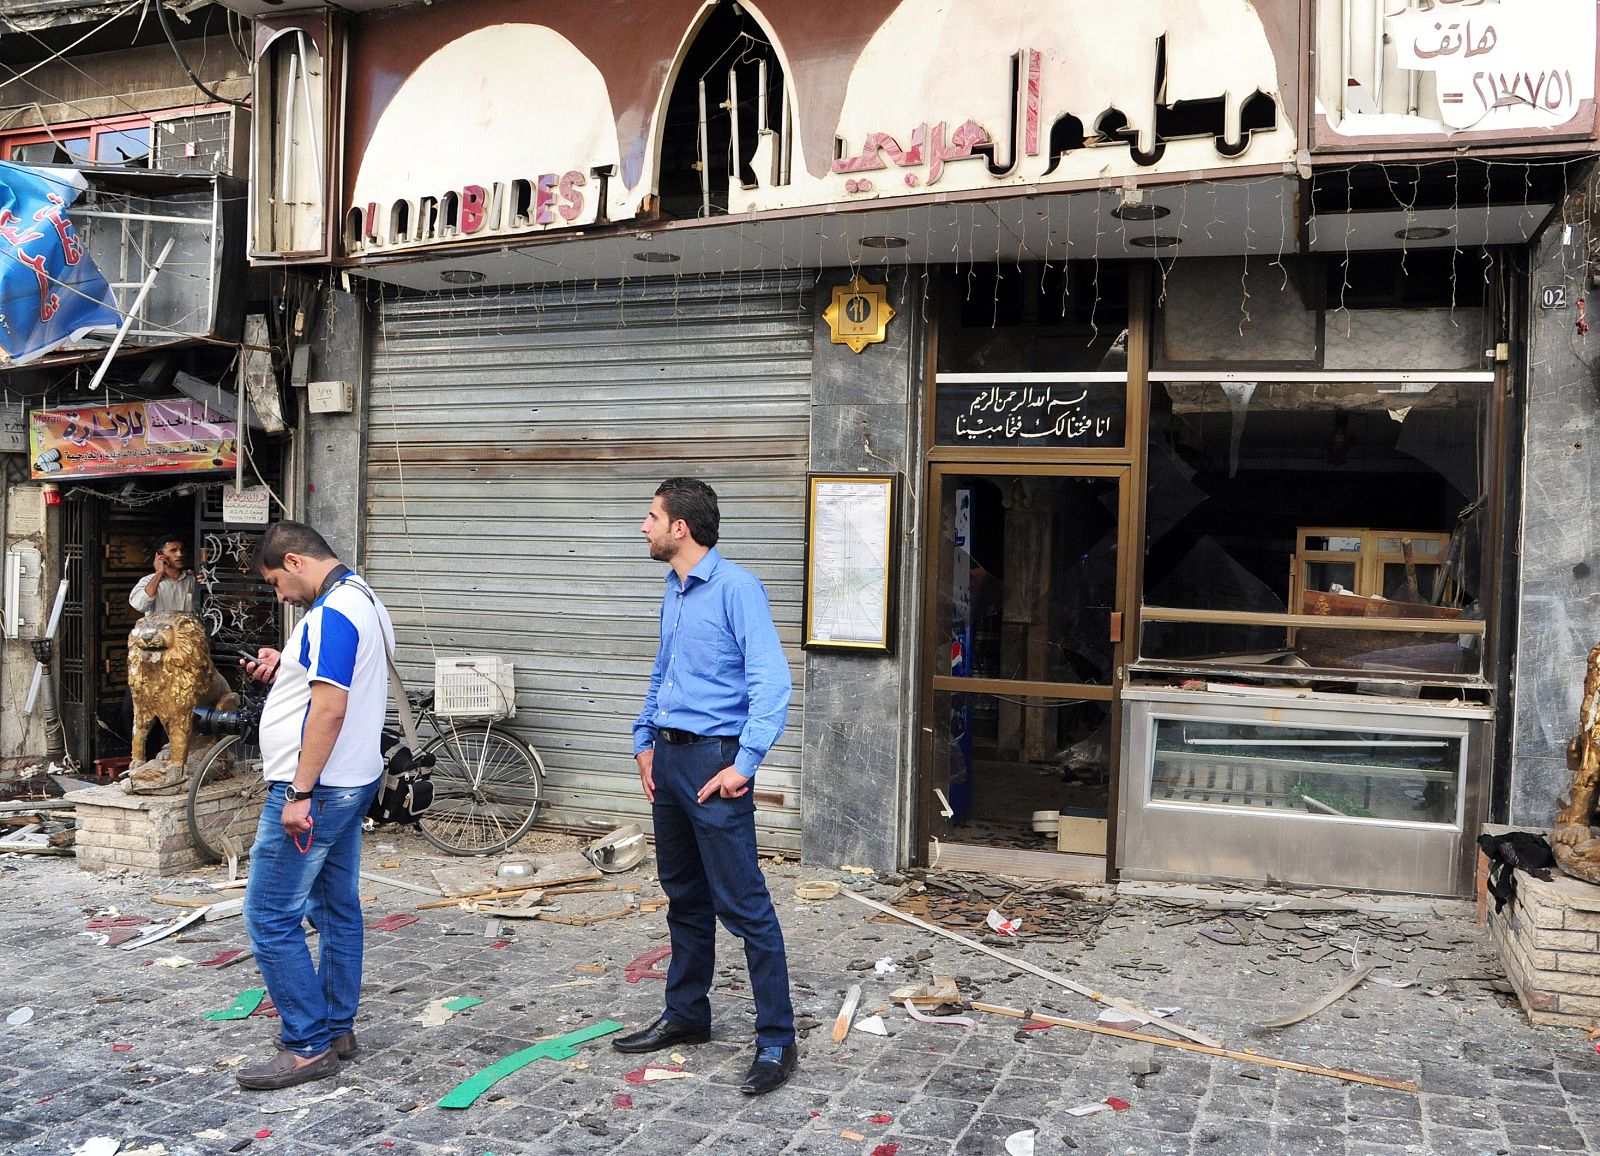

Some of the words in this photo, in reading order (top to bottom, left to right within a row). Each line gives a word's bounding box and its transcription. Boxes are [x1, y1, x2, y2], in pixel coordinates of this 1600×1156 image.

[1413, 19, 1497, 59] هاتف
[832, 47, 1041, 193] العربي
[1544, 289, 1563, 305] 02
[970, 387, 1000, 416] الرحيم
[994, 387, 1033, 412] الرحمن
[1027, 386, 1051, 409] الله
[1048, 390, 1088, 415] بسم
